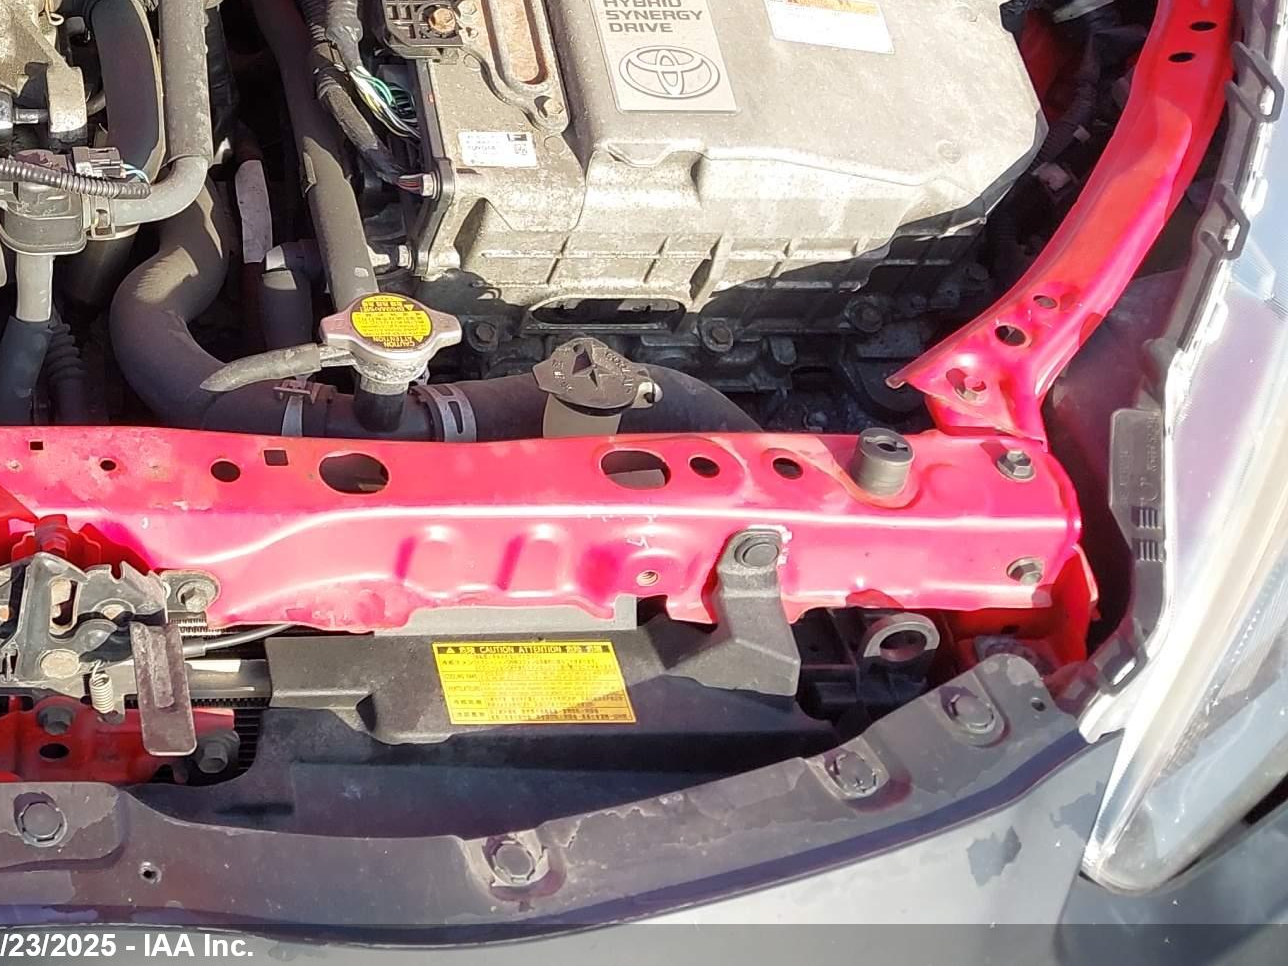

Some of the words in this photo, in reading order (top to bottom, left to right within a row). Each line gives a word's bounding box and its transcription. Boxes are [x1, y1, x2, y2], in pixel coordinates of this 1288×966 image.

[605, 10, 703, 21] SYNERGY
[608, 22, 673, 33] DRIVE
[479, 645, 515, 655] CAUTION
[517, 645, 563, 655] ATTENTION
